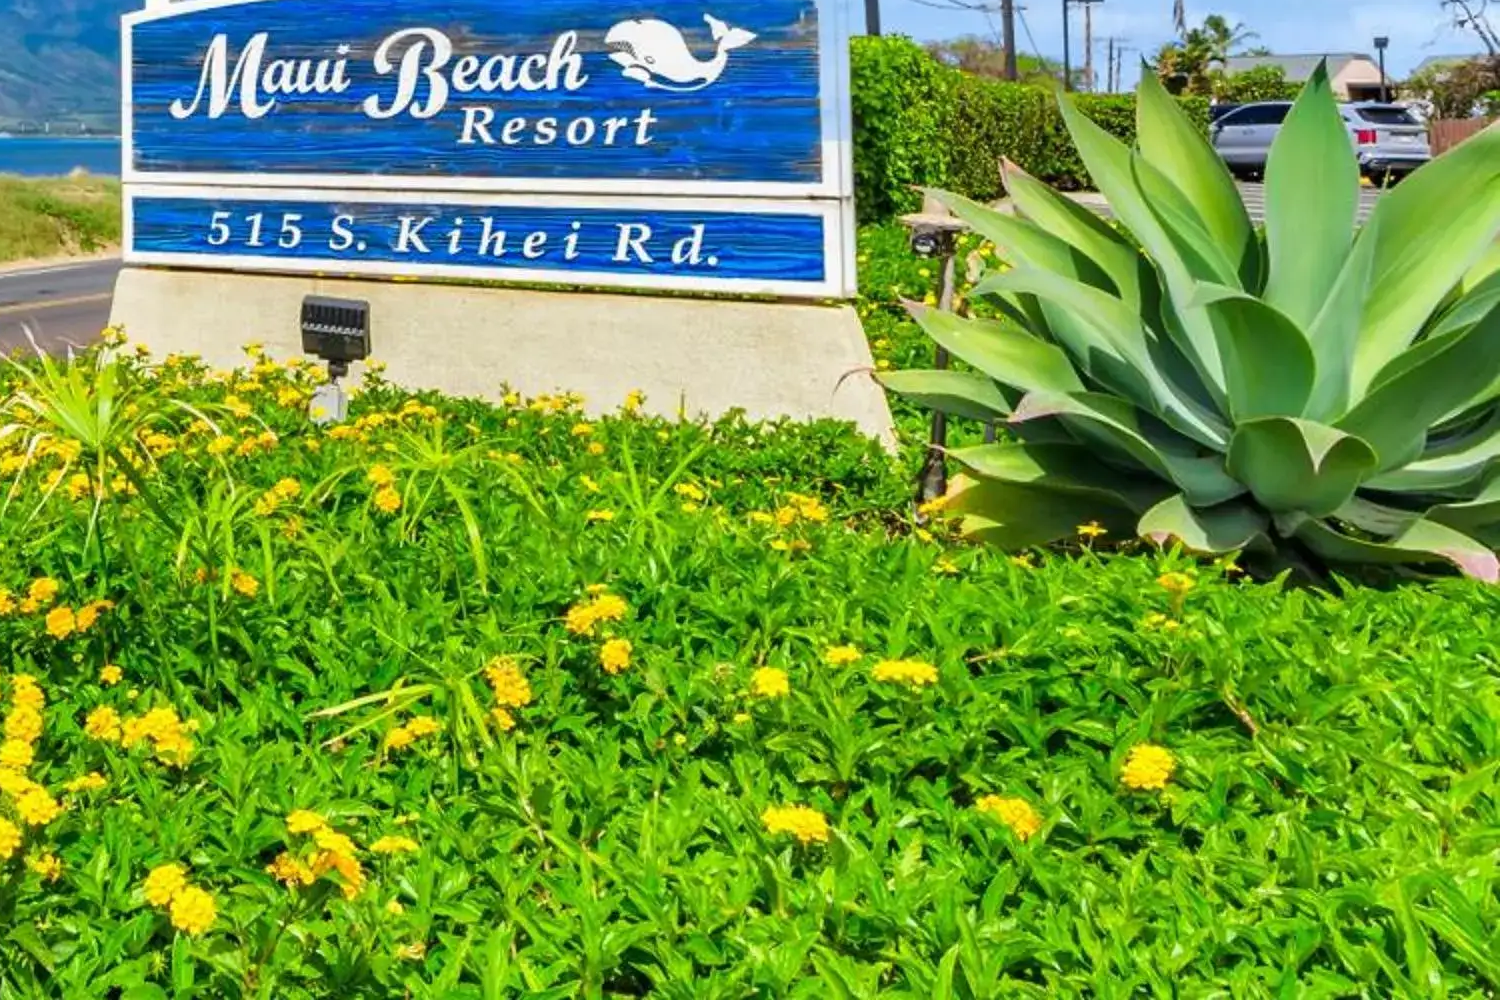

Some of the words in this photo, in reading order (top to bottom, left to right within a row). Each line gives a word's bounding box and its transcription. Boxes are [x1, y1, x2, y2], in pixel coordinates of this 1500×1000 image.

[168, 31, 351, 120] Maui
[362, 26, 589, 120] Beach
[456, 105, 658, 146] Resort
[206, 210, 303, 249] 515
[328, 214, 368, 252] S.
[392, 215, 582, 261] Kihei
[611, 221, 720, 267] Rd.
